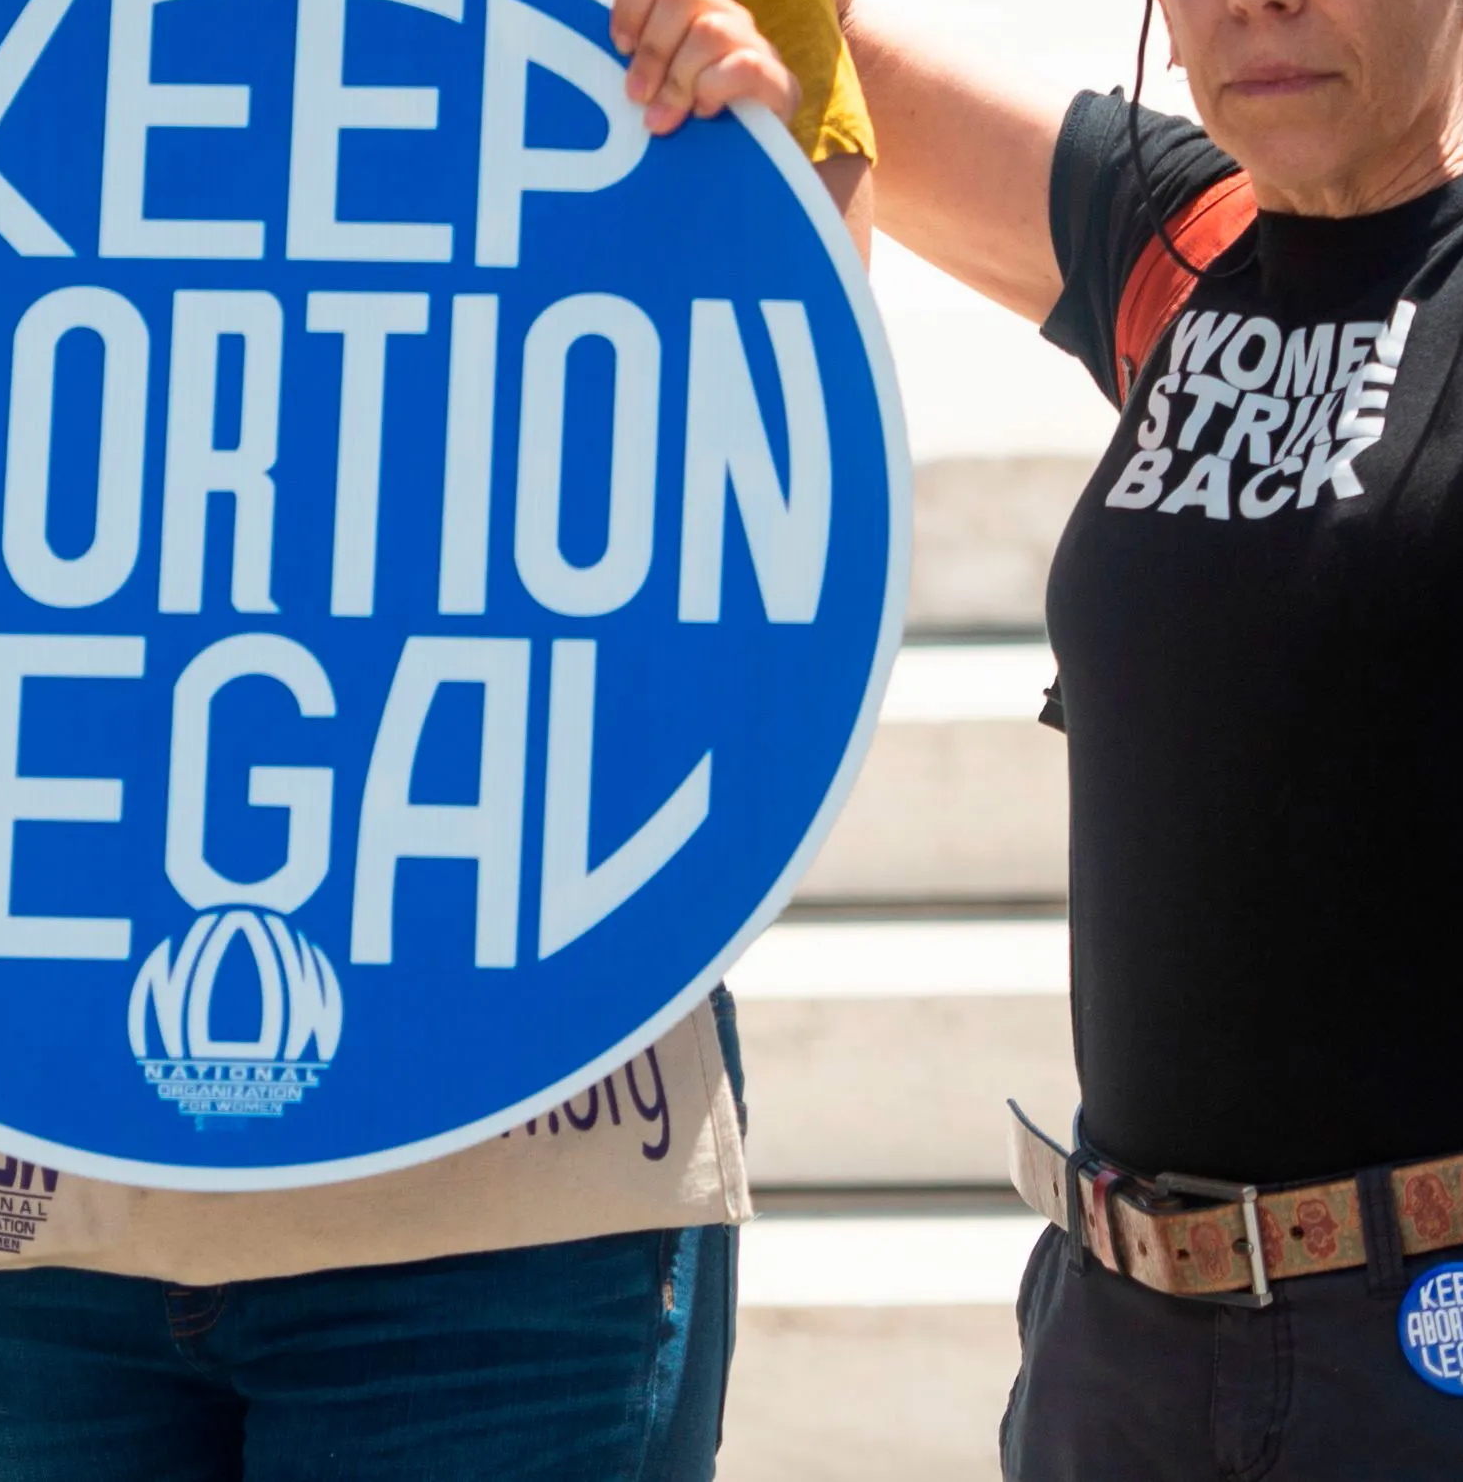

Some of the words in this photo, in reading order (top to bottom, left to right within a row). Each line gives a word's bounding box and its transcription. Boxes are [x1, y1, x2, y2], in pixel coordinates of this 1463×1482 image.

[1104, 436, 1385, 521] BACK
[128, 911, 344, 1063] NOW
[145, 1065, 318, 1084] NATIONAL
[158, 1084, 302, 1101] ORGANIZATION
